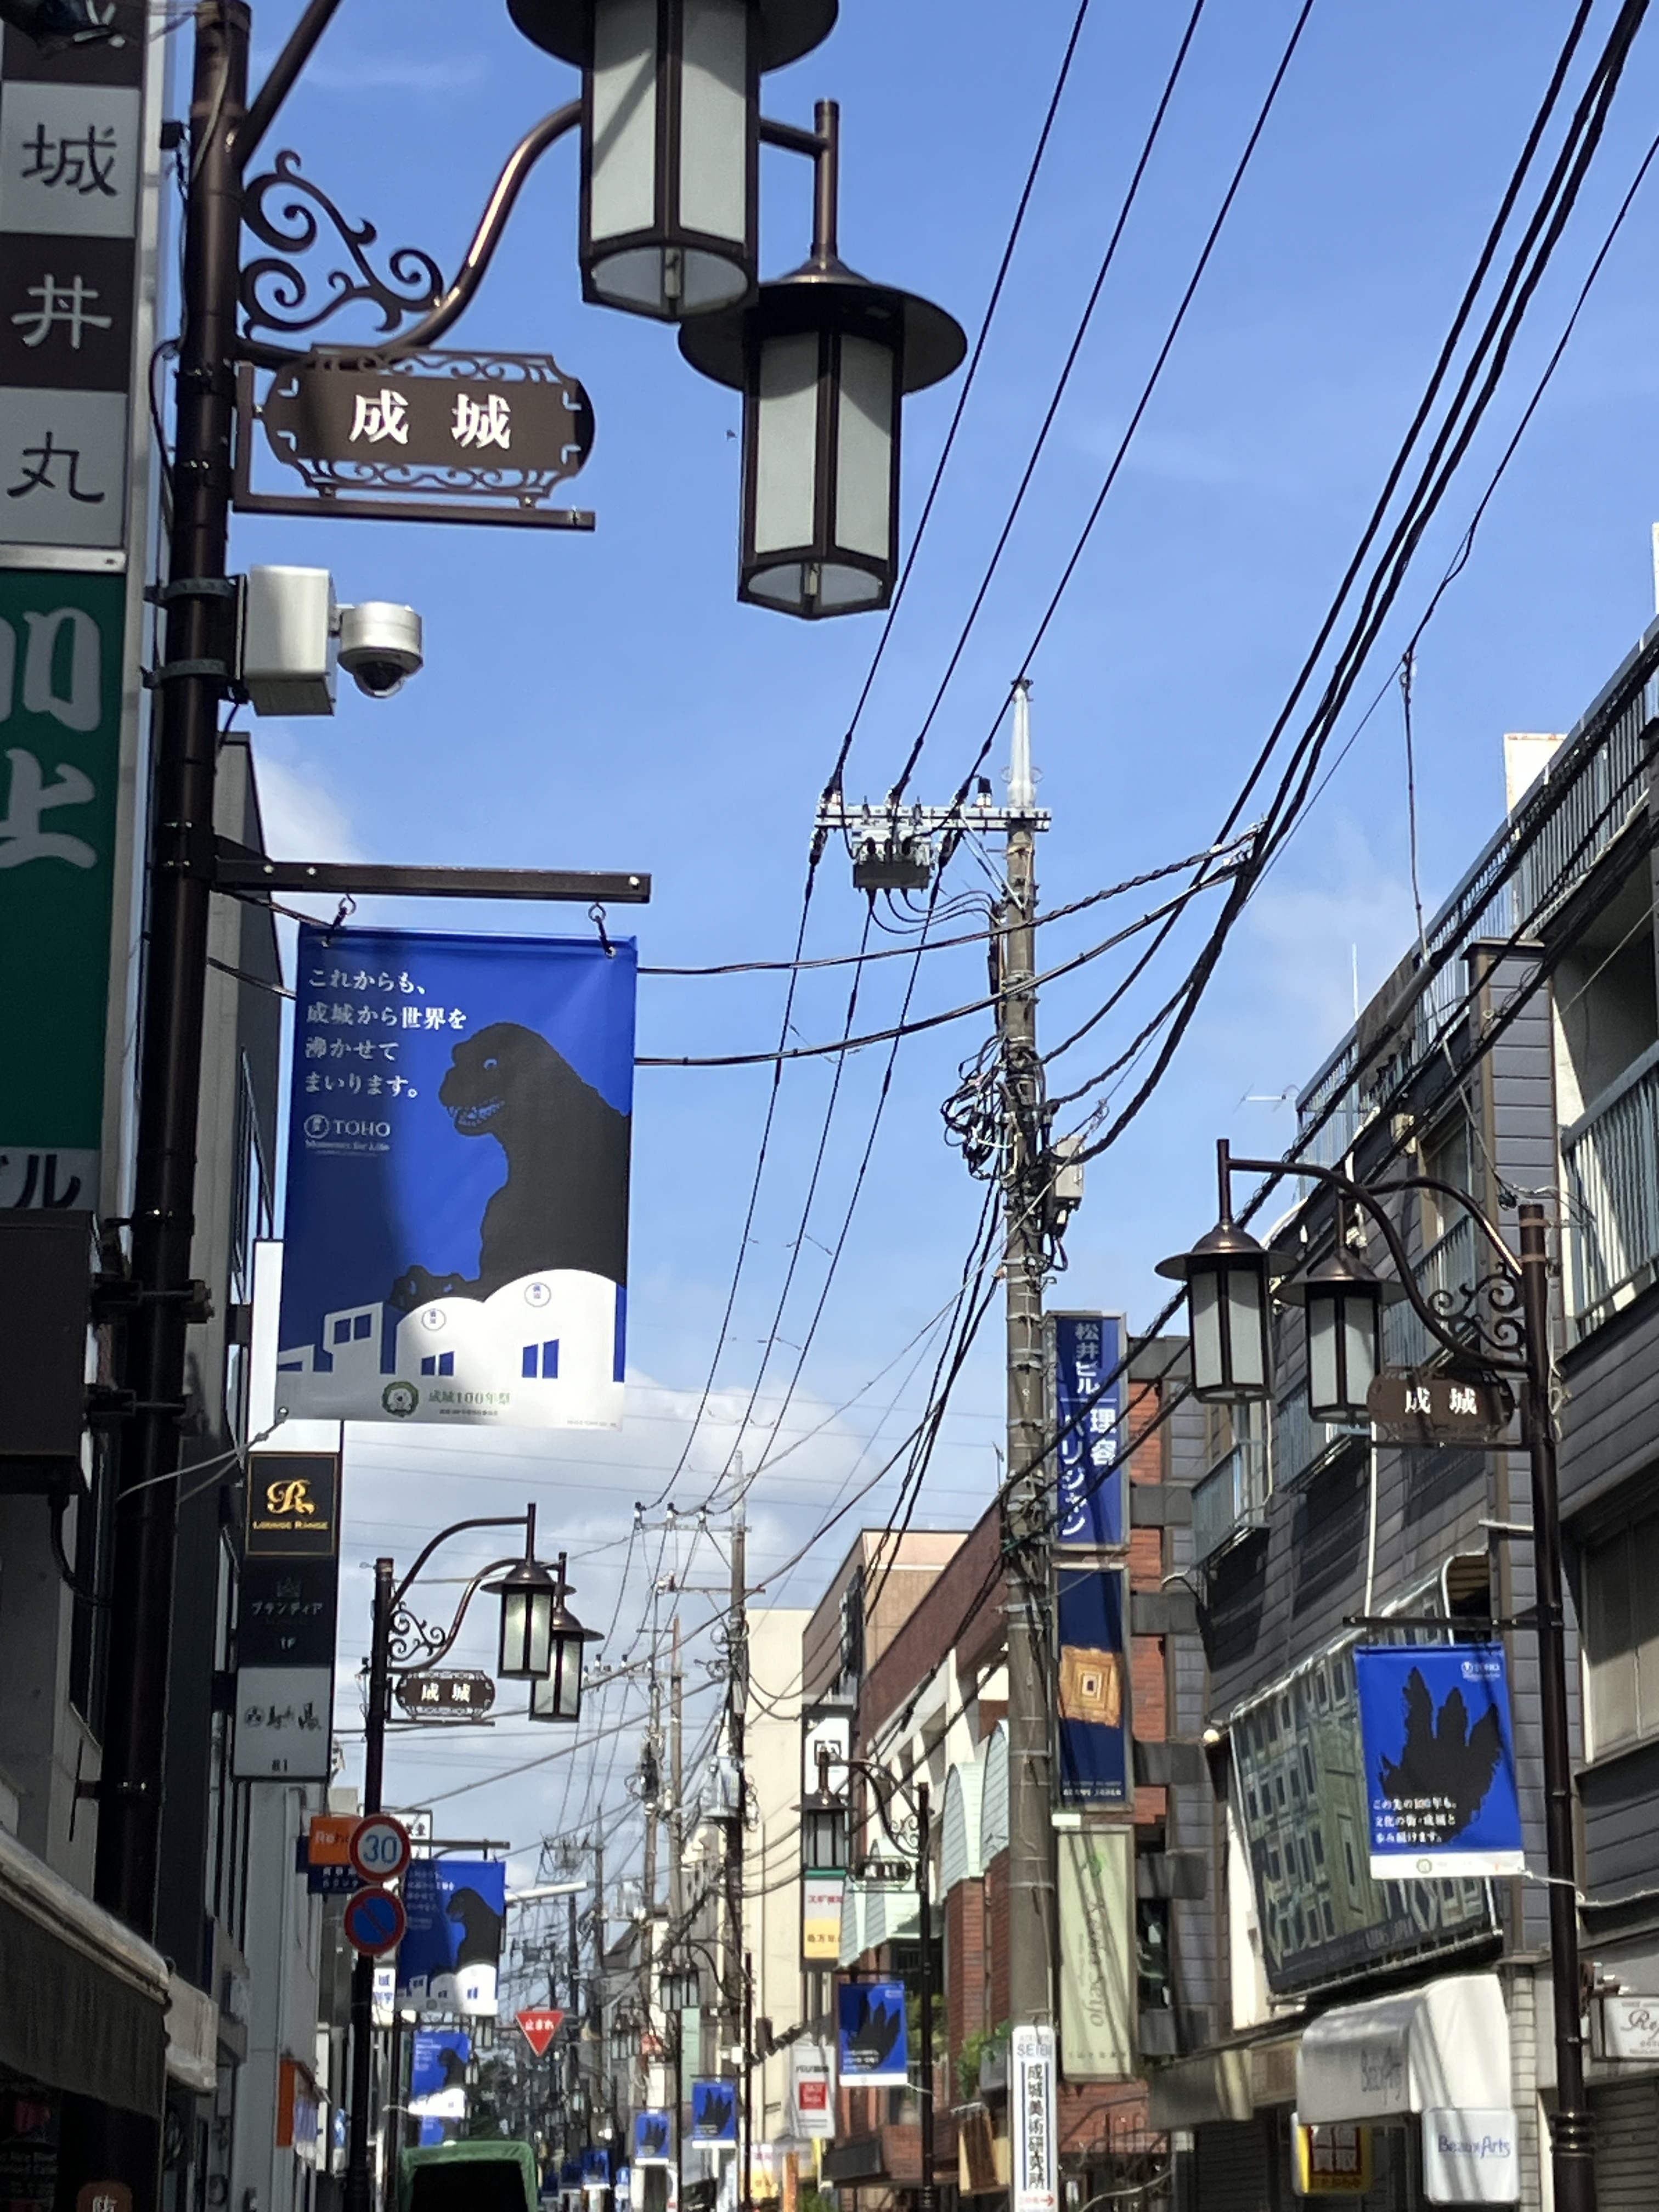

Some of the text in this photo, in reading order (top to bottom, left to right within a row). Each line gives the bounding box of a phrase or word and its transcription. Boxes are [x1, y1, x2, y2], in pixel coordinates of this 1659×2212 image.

[306, 1001, 467, 1030] 成城から世界を
[305, 1071, 418, 1098] まいります。
[333, 1120, 391, 1137] TOHO
[1075, 1322, 1100, 1395] 松井ビル
[1090, 1408, 1117, 1466] 理容
[363, 1834, 397, 1864] 30
[1026, 2063, 1045, 2190] 成城美術研究所
